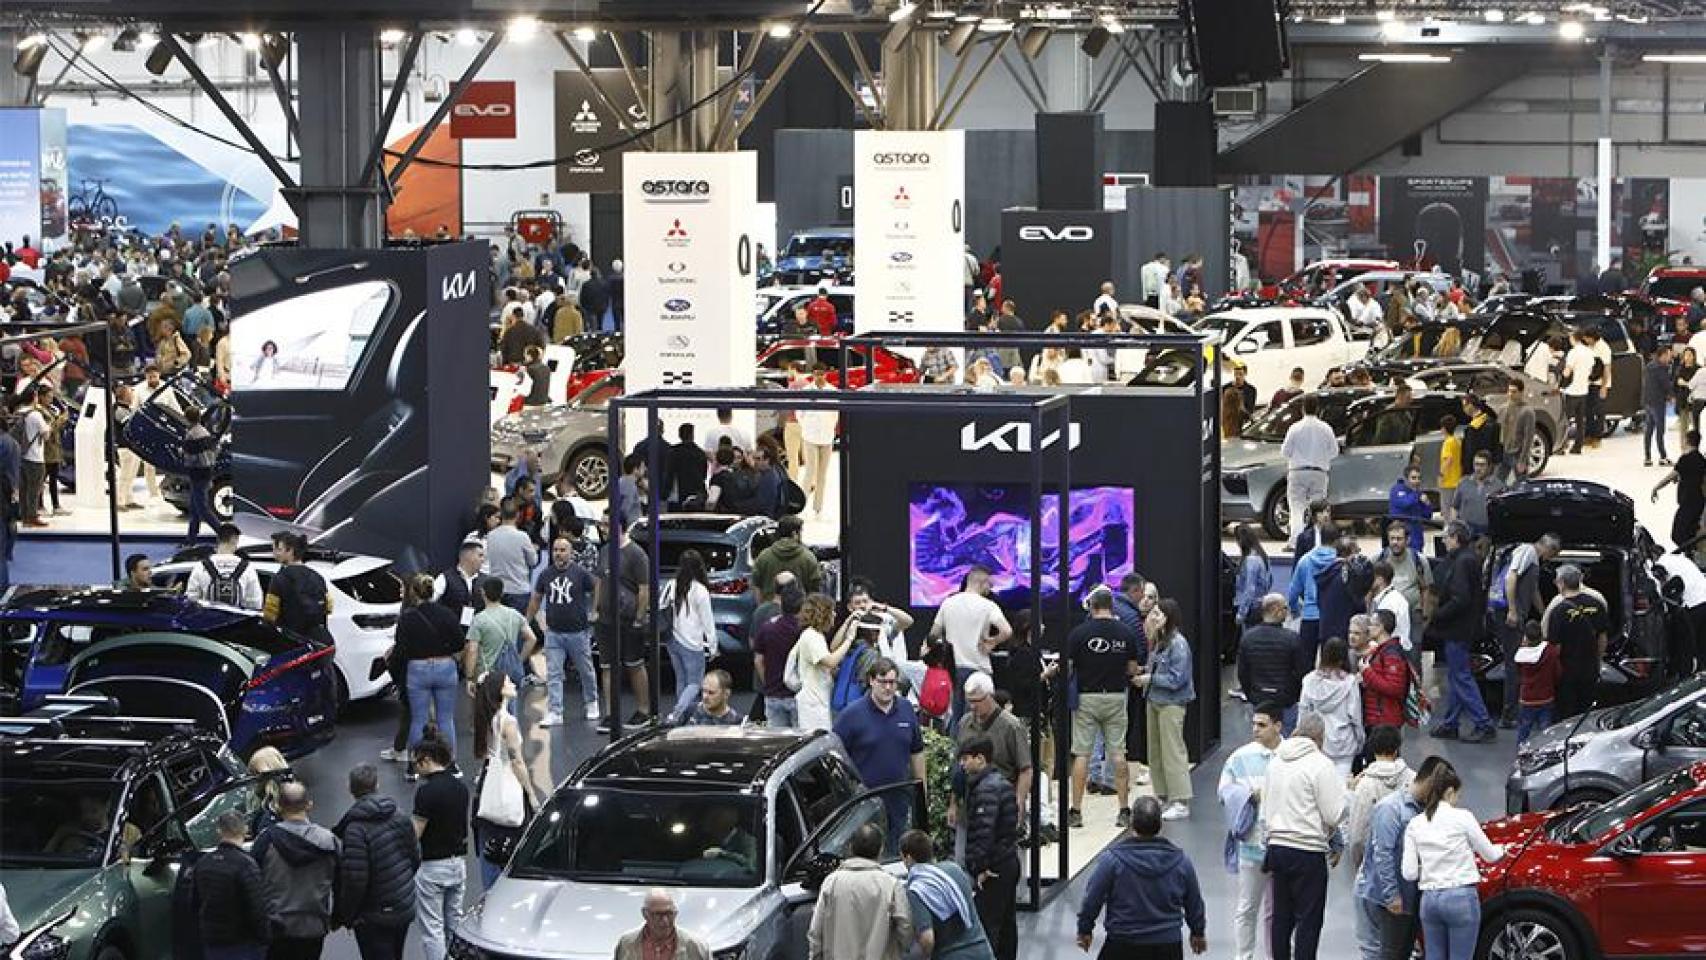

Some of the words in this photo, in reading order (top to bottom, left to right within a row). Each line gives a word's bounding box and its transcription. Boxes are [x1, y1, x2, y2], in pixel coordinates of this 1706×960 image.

[455, 103, 511, 117] EVO
[873, 152, 930, 164] astara
[641, 179, 710, 195] astara
[1019, 225, 1093, 240] EVO
